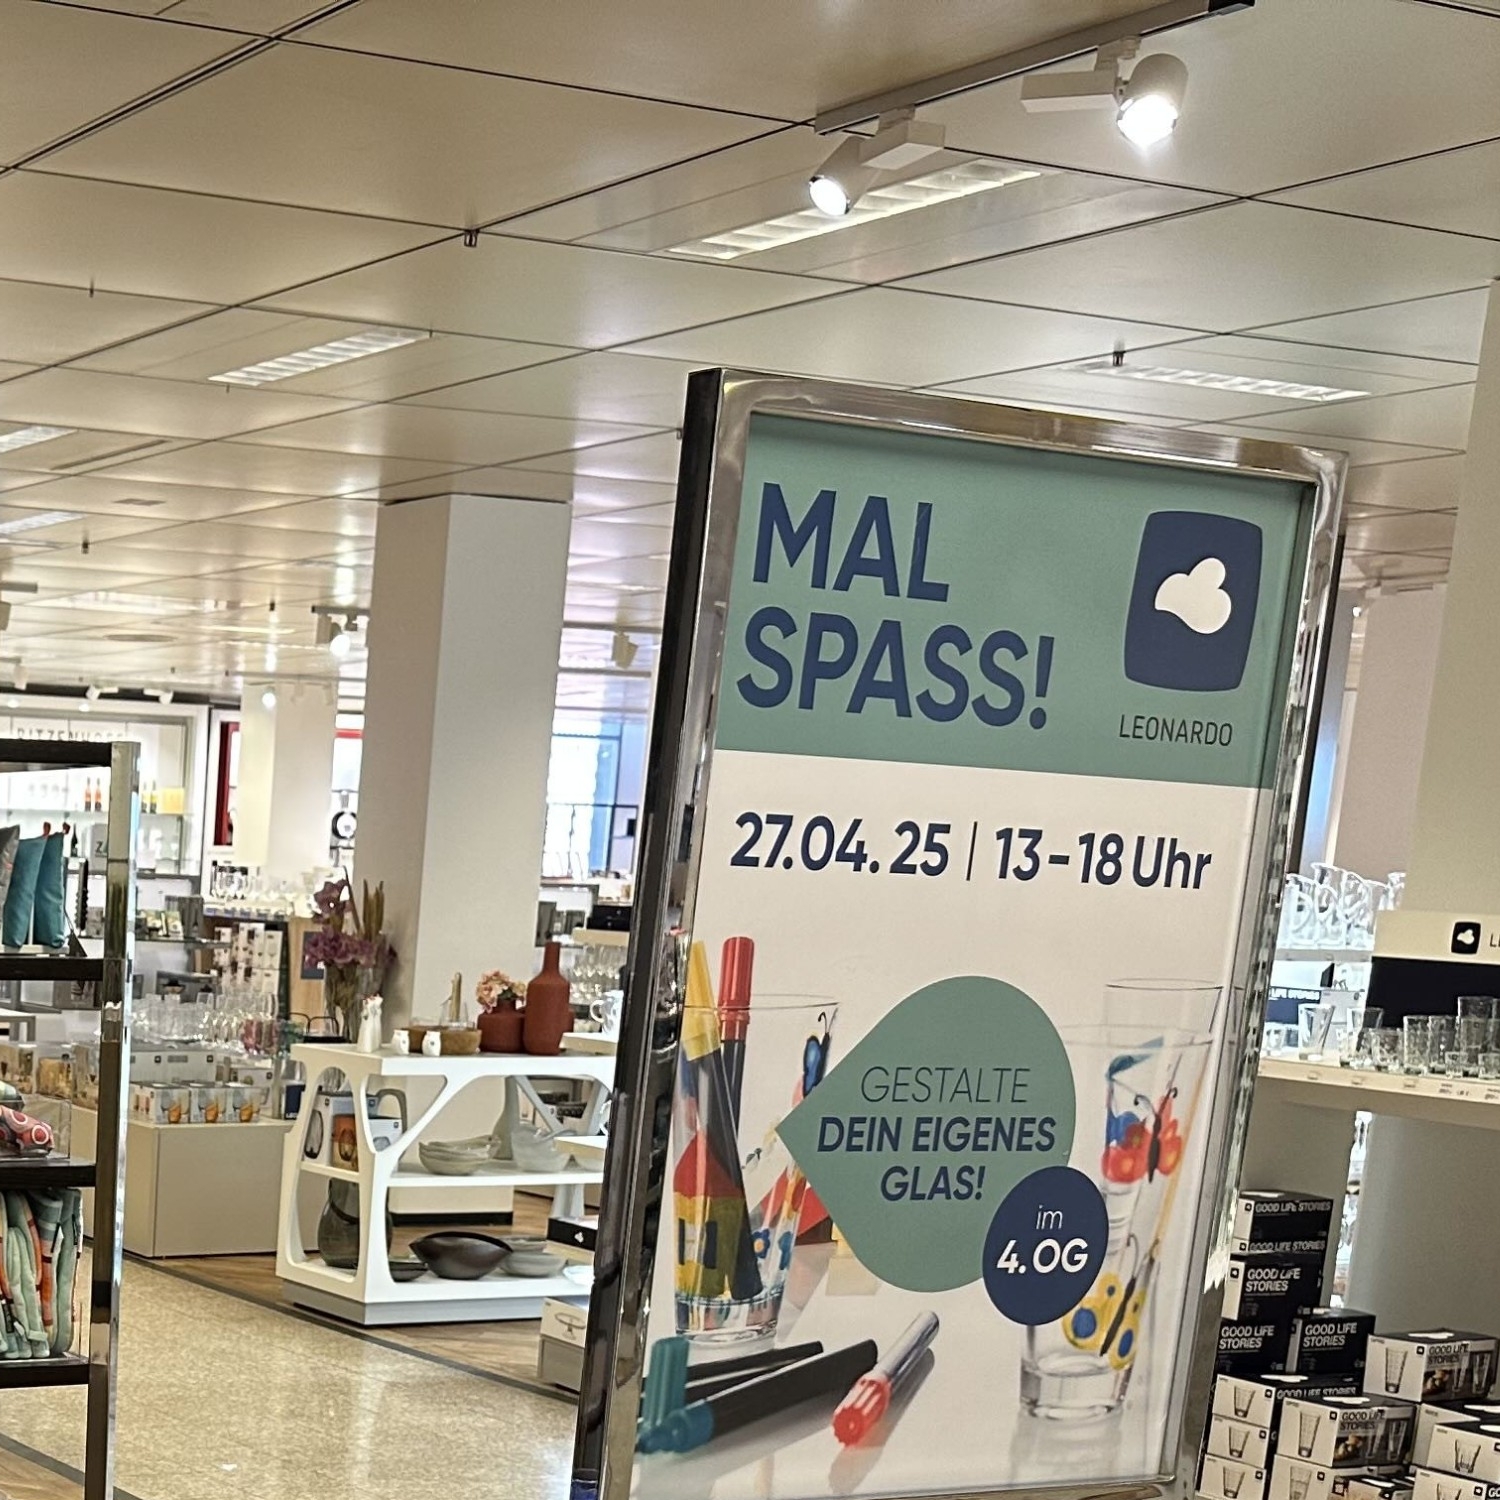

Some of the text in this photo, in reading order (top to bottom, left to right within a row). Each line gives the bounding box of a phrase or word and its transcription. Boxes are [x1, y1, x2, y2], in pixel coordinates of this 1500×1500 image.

[752, 481, 950, 603] MAL
[736, 606, 1056, 731] SPASS!
[1118, 713, 1234, 748] LEONARDO
[729, 810, 952, 877] 27.04.25
[1130, 835, 1213, 890] Uhr
[860, 1065, 1031, 1105] GESTALTE
[817, 1115, 1057, 1153] DEIN EIGENES
[879, 1165, 987, 1202] GLAS!
[1255, 1202, 1280, 1213] GOOD
[1298, 1201, 1331, 1212] STORIES
[1035, 1204, 1064, 1231] im
[1292, 1240, 1326, 1251] STORIES
[1247, 1267, 1301, 1280] GOOD LIFE
[1245, 1280, 1289, 1292] STORIES
[1221, 1325, 1275, 1338] GOOD LIFE
[1304, 1322, 1358, 1336] GOOD LIFE
[1219, 1337, 1263, 1349] STORIES
[1303, 1335, 1346, 1347] STORIES
[1428, 1345, 1452, 1356] GOOD
[1341, 1411, 1368, 1421] GOOD
